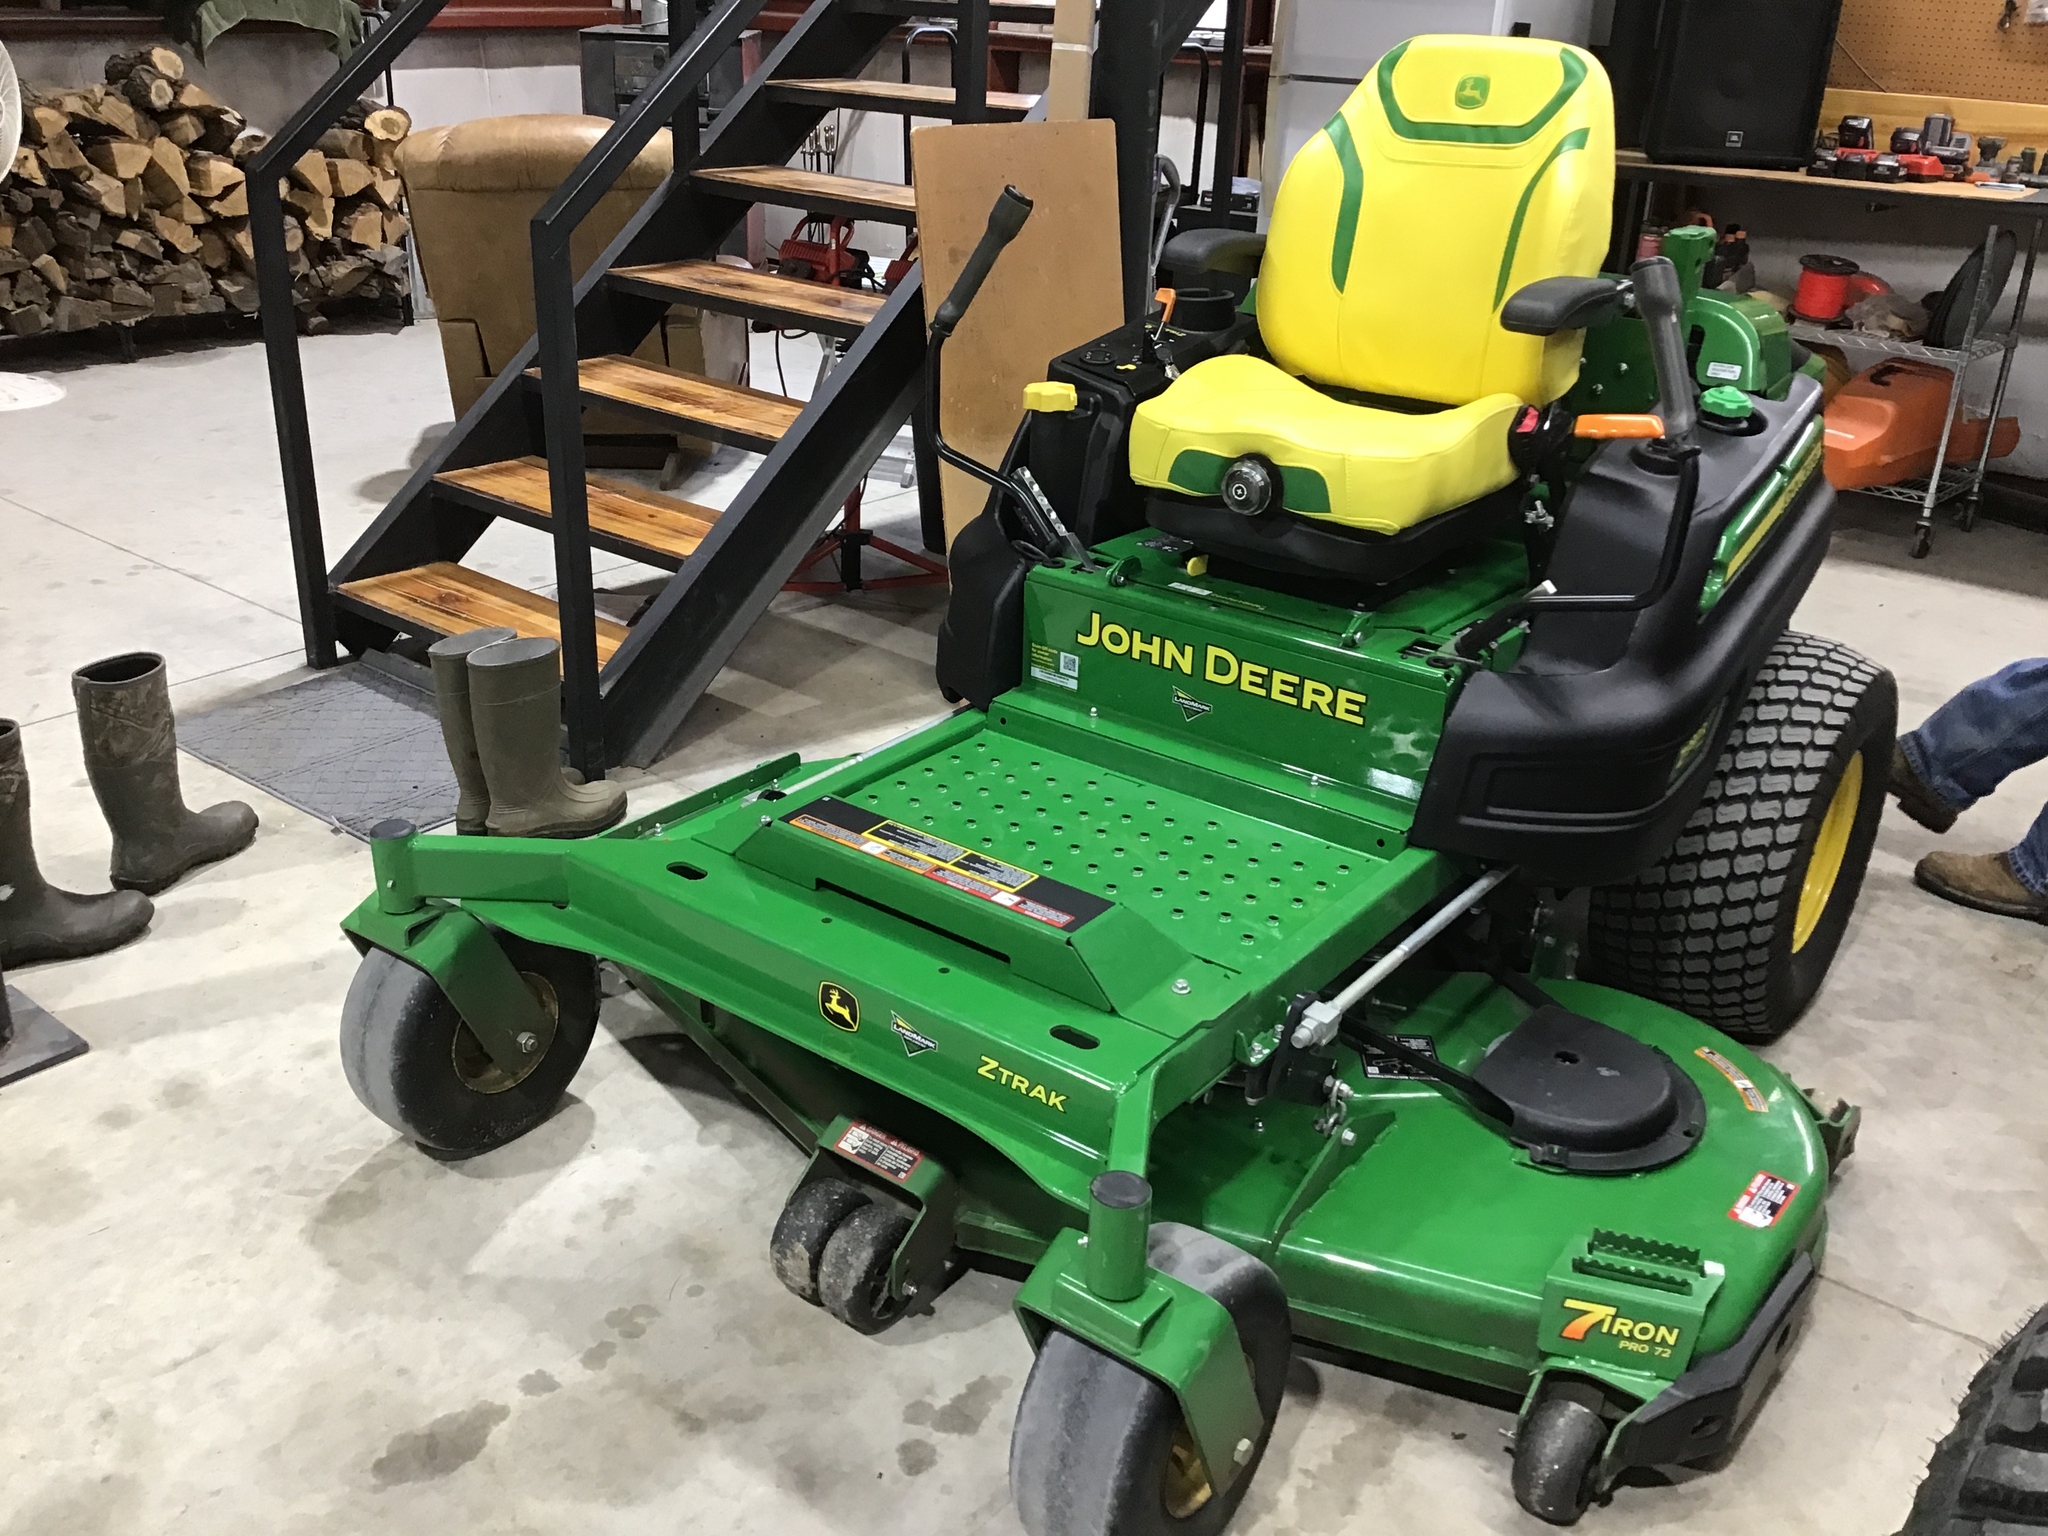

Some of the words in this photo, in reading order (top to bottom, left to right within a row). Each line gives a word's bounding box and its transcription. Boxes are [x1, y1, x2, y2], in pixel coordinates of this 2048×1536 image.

[1077, 612, 1194, 675] JOHN
[1205, 644, 1367, 725] DEERE
[893, 1023, 936, 1049] LANDMARK
[977, 1055, 1067, 1113] ZTRAK
[1619, 1340, 1650, 1354] PRO
[1654, 1347, 1672, 1358] 72
